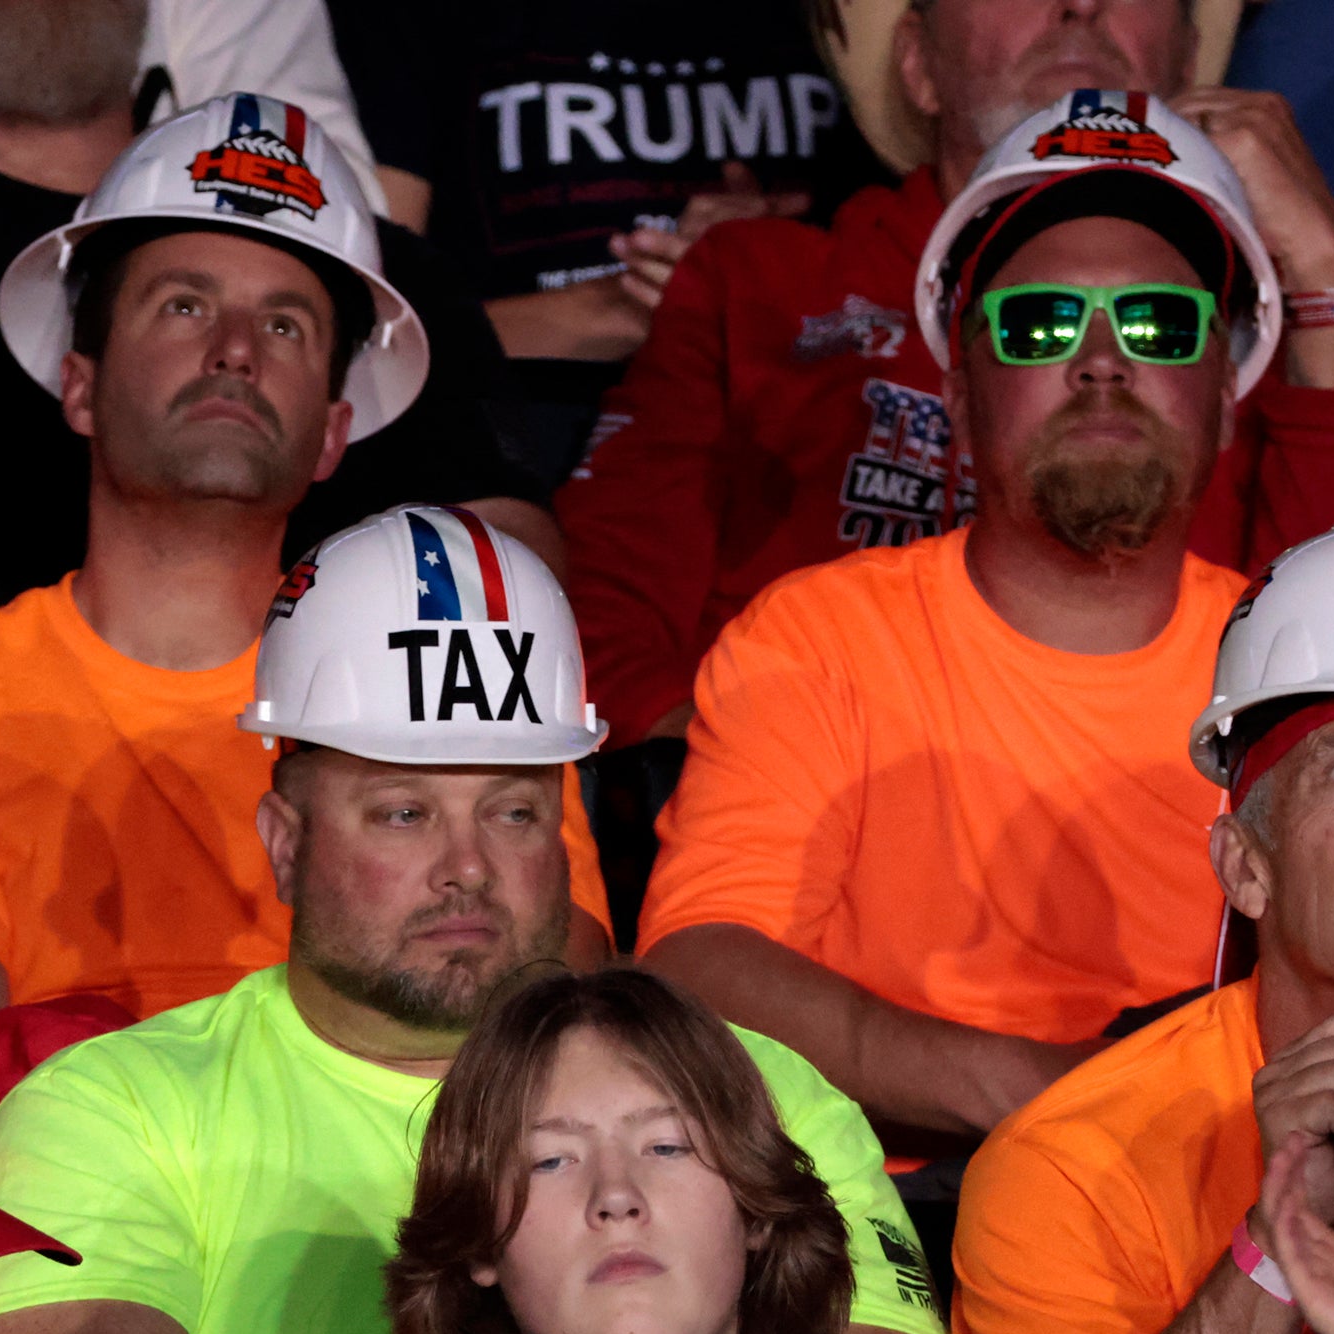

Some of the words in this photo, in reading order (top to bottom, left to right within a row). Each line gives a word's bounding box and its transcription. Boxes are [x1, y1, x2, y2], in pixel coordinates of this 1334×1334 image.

[478, 73, 841, 173] TRUMP
[1034, 128, 1173, 165] HES
[191, 149, 323, 210] HES
[853, 465, 923, 505] TAKE
[388, 629, 543, 724] TAX
